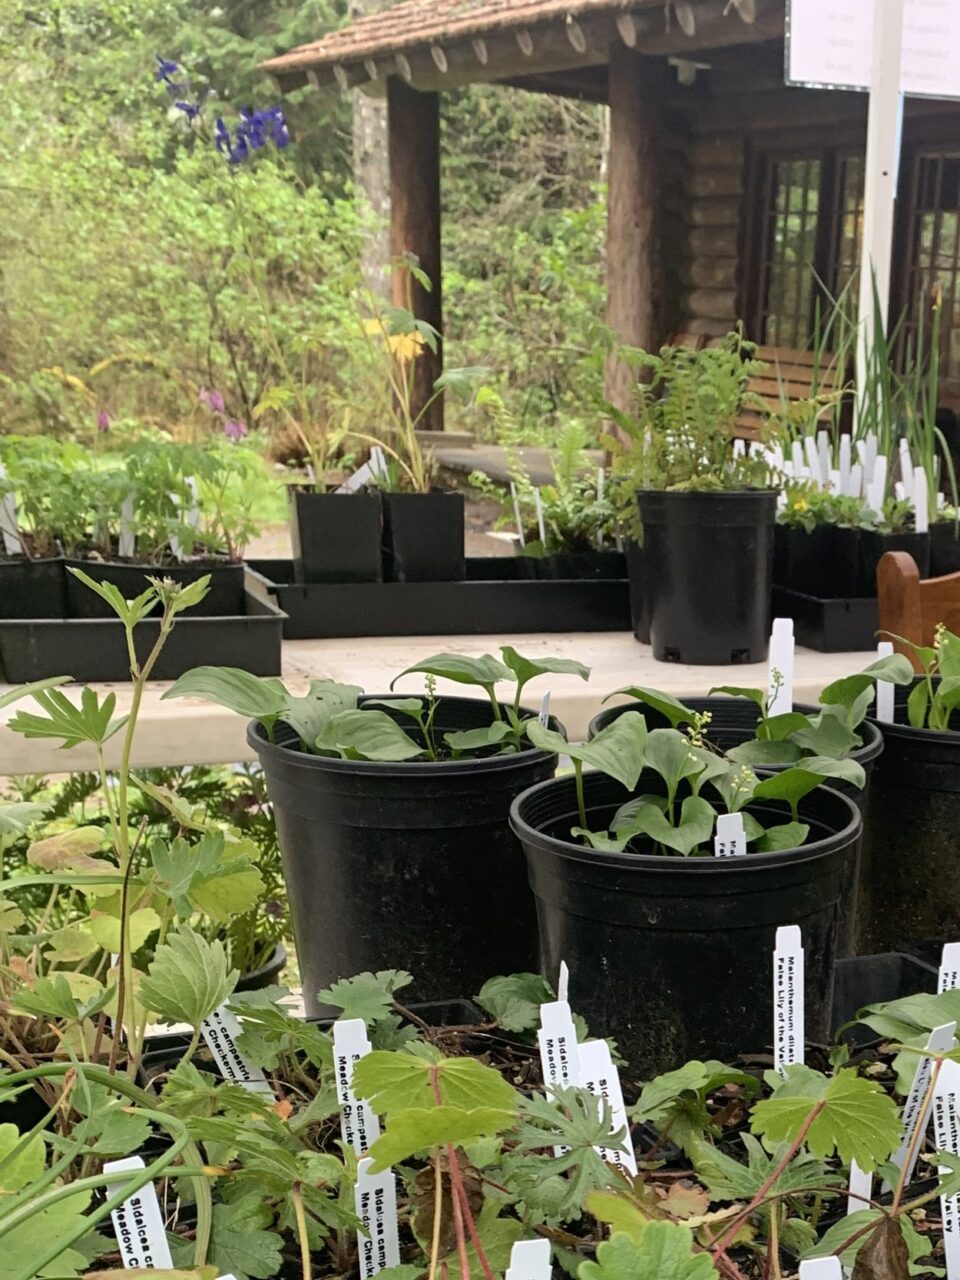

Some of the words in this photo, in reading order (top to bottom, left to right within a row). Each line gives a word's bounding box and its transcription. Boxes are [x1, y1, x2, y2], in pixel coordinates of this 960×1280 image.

[777, 990, 785, 1007] Lily
[778, 1012, 784, 1022] of
[337, 1055, 350, 1102] Meadow
[935, 1096, 944, 1128] False
[129, 1197, 150, 1252] Sidalcea
[374, 1187, 384, 1235] Sidalcea
